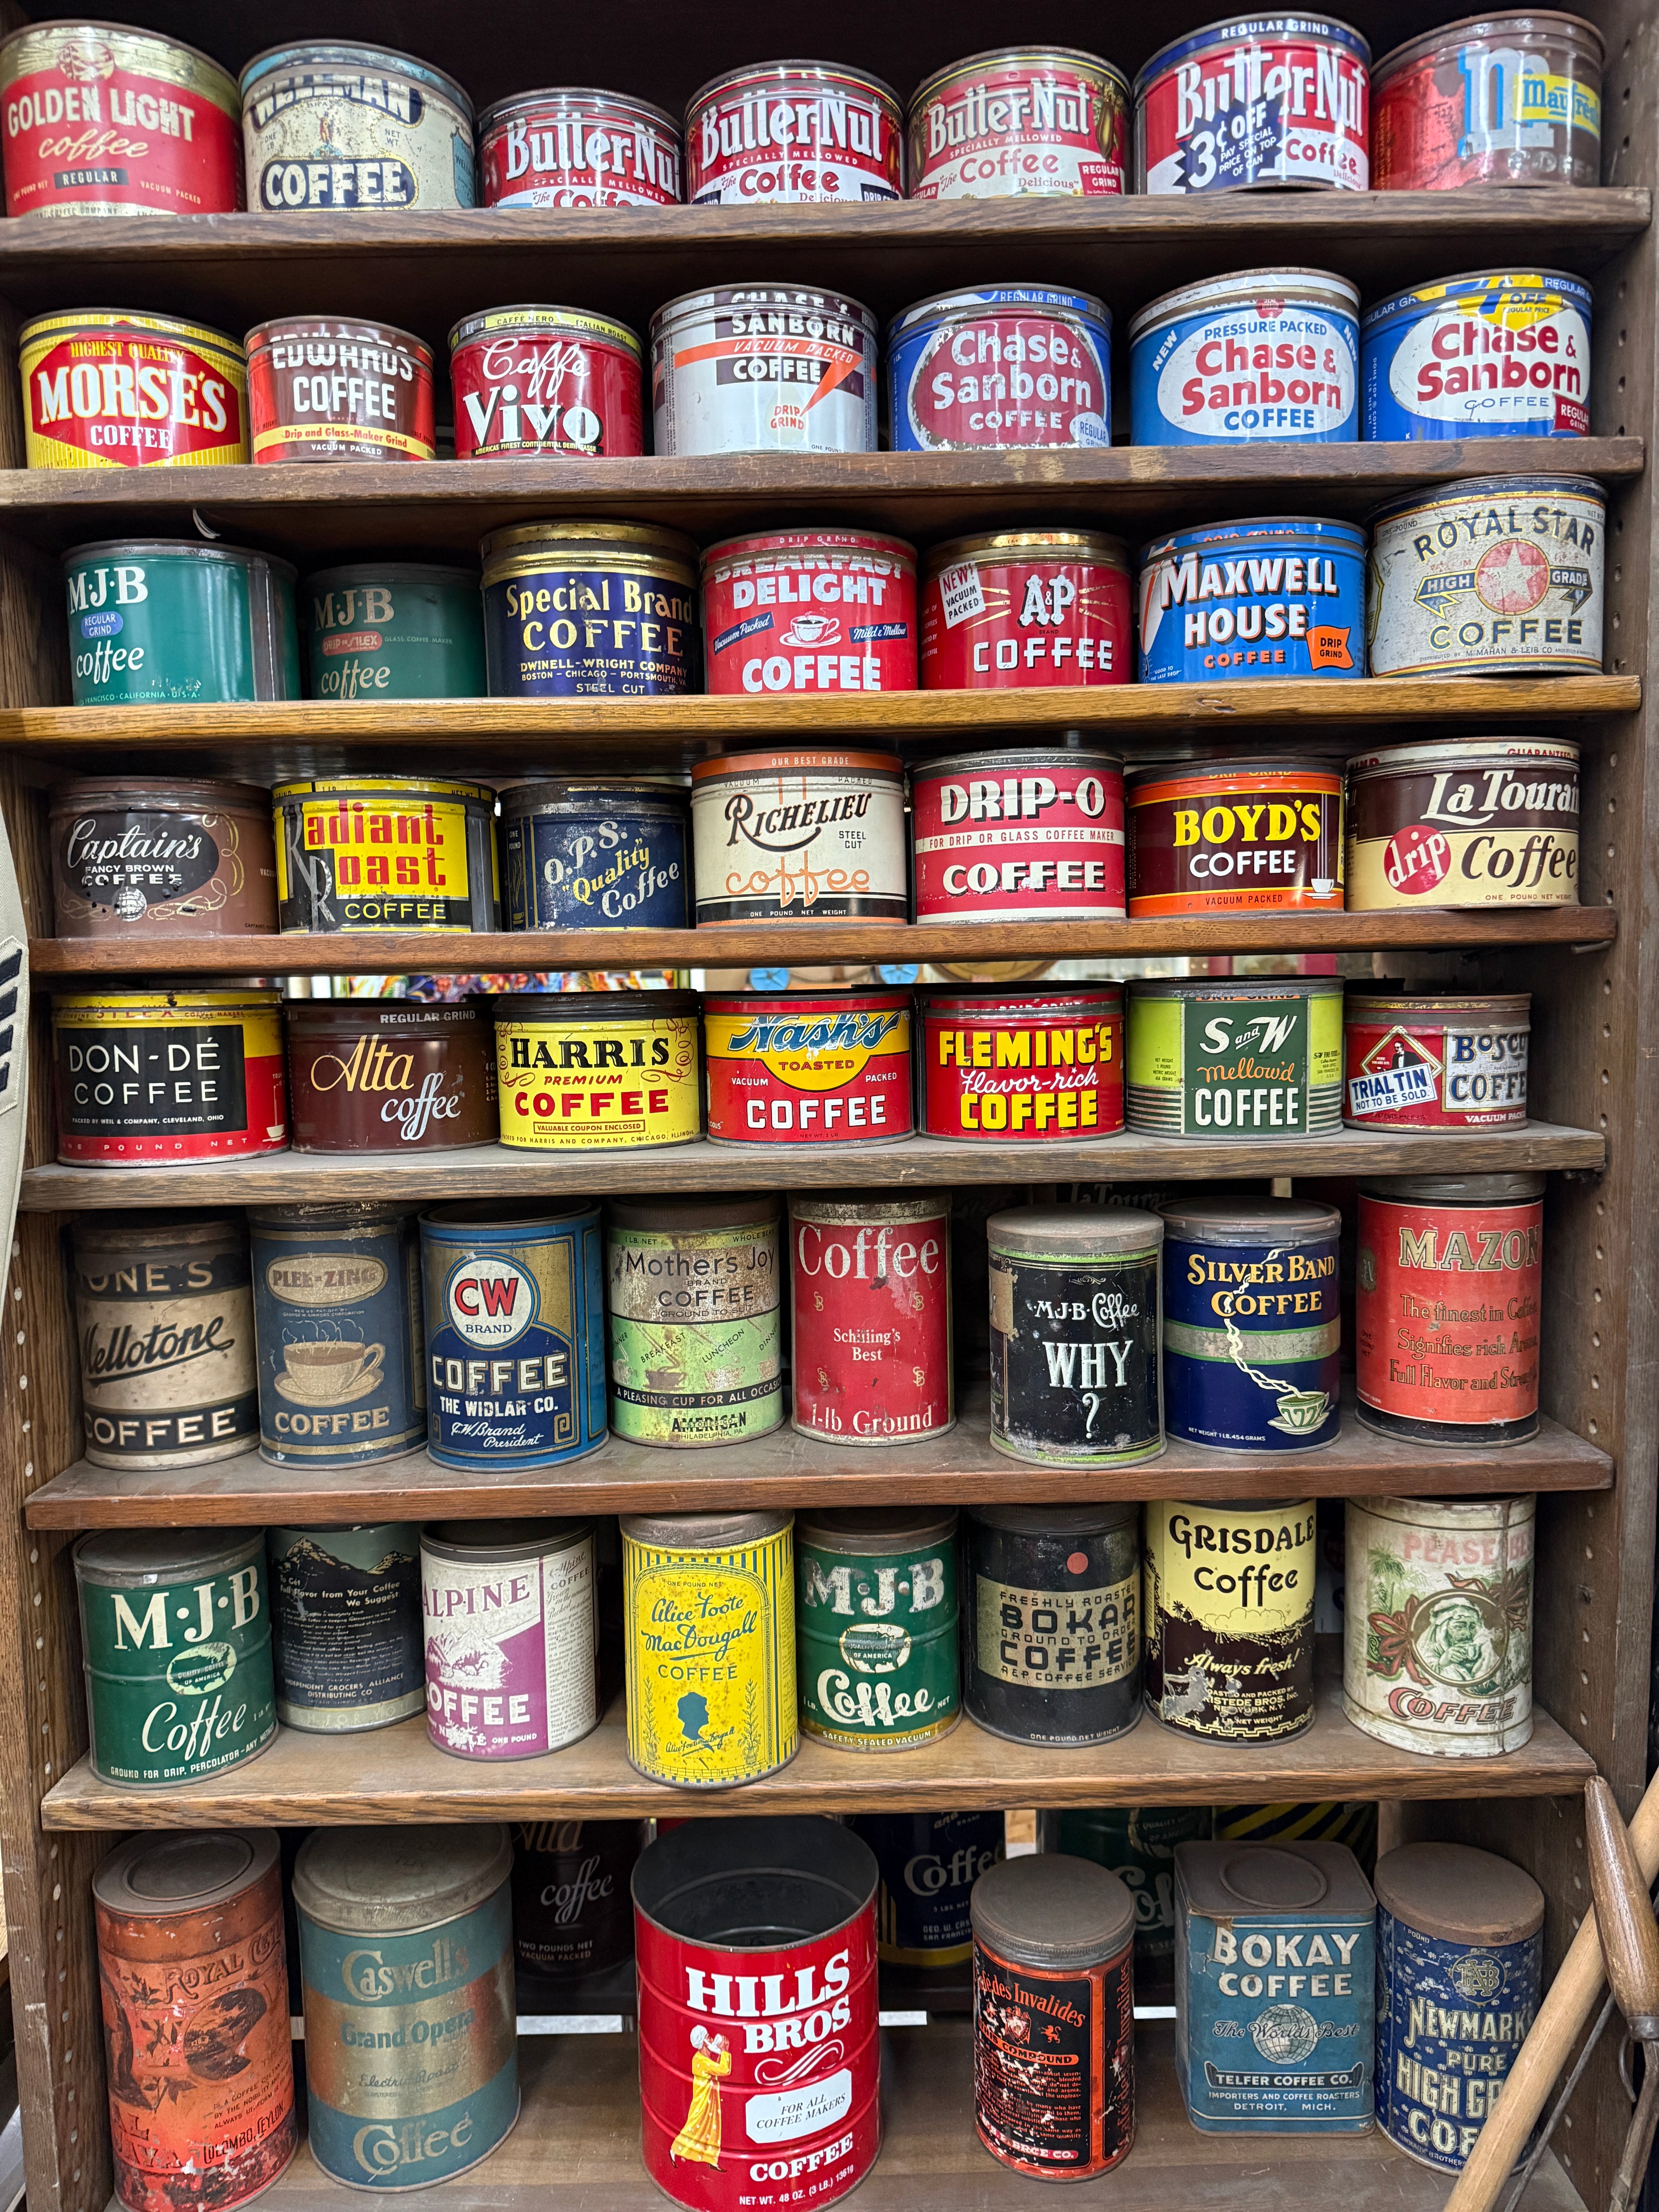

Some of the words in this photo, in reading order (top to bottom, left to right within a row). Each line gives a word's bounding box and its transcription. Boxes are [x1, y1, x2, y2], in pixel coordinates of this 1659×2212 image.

[1221, 21, 1285, 38] REGULAR
[1290, 19, 1329, 35] GRIND
[7, 84, 101, 137] GOLDEN
[110, 88, 195, 142] LIGHT
[1231, 101, 1267, 139] OFF
[39, 130, 151, 163] coffee
[62, 172, 118, 186] REGULAR
[1082, 165, 1120, 177] REGULAR
[140, 181, 172, 194] VACUUM
[176, 190, 201, 204] PACKED
[266, 161, 407, 206] COFFEE
[1092, 177, 1117, 187] GRIND
[1204, 321, 1278, 339] PRESSURE
[1280, 321, 1328, 336] PACKED
[70, 341, 123, 358] HIGHEST
[128, 343, 185, 364] QUALITY
[734, 340, 799, 352] VACUUM
[805, 342, 853, 363] PACKED
[1195, 338, 1317, 376] Chase
[1323, 348, 1336, 374] &
[733, 359, 821, 381] COFFEE
[37, 363, 226, 433] MORSE'S
[294, 376, 396, 420] COFFEE
[1182, 372, 1341, 415] Sanborn
[463, 384, 601, 445] Vivo
[774, 405, 800, 417] DRIP
[1224, 409, 1315, 430] COFFEE
[770, 417, 804, 430] GRIND
[90, 425, 171, 448] COFFEE
[285, 427, 302, 439] Drip
[305, 428, 321, 438] and
[326, 428, 383, 445] Glass-Maker
[385, 435, 408, 448] Grind
[311, 443, 347, 453] VACUUM
[350, 445, 382, 455] PACKED
[1161, 551, 1338, 609] MAXWELL
[1427, 573, 1470, 594] HIGH
[507, 579, 611, 618] Special
[624, 579, 693, 624] Brand
[733, 573, 886, 610] DELIGHT
[84, 614, 116, 627] REGULAR
[88, 624, 112, 636] GRIND
[1185, 603, 1309, 647] HOUSE
[1320, 637, 1343, 649] DRIP
[1476, 647, 1506, 656] MAHAN
[1204, 650, 1286, 669] COFFEE
[1319, 649, 1343, 659] GRIND
[520, 658, 634, 672] DWINELL-WRIGHT
[639, 662, 688, 677] COMPANY
[576, 684, 615, 694] STEEL
[622, 684, 645, 694] CUT
[771, 757, 790, 766] OUR
[794, 757, 817, 766] BEST
[821, 757, 850, 765] GRADE
[940, 777, 1106, 824] DRIP-O
[1173, 800, 1321, 847] BOYD'S
[839, 831, 866, 840] STEEL
[929, 838, 944, 849] FOR
[949, 834, 973, 845] DRIP
[979, 833, 993, 843] OR
[1001, 831, 1039, 842] GLASS
[1046, 830, 1084, 840] COFFEE
[1090, 831, 1115, 841] MAKER
[85, 864, 122, 874] FANCY
[125, 864, 175, 873] BROWN
[1388, 831, 1446, 888] drip
[1205, 895, 1243, 905] VACUUM
[1248, 895, 1283, 903] PACKED
[345, 903, 446, 919] COFFEE
[381, 1013, 439, 1024] REGULAR
[443, 1010, 476, 1021] GRIND
[510, 1037, 670, 1068] HARRIS
[939, 1023, 1112, 1068] FLEMING'S
[778, 1060, 855, 1071] TOASTED
[544, 1075, 622, 1085] PREMIUM
[732, 1077, 768, 1086] VACUUM
[865, 1073, 897, 1082] PACKED
[1352, 1076, 1394, 1100] TRIAL
[1395, 1068, 1427, 1088] TIN
[381, 1071, 463, 1141] coffee
[1196, 1087, 1298, 1126] COFFEE
[1356, 1100, 1370, 1111] NOT
[1386, 1095, 1398, 1104] BE
[1401, 1090, 1430, 1102] SOLD.
[598, 1123, 641, 1131] ENCLOSED
[1187, 1254, 1284, 1285] SILVER
[1287, 1254, 1334, 1282] BAND
[455, 1278, 519, 1316] CW
[1211, 1291, 1322, 1317] COFFEE
[465, 1324, 512, 1334] BRAND
[833, 1328, 900, 1344] Schilling's
[640, 1332, 686, 1364] BREAKFAST
[701, 1328, 745, 1364] LUNCHEON
[852, 1348, 882, 1361] Best
[1042, 1340, 1134, 1388] WHY
[440, 1397, 461, 1413] THE
[465, 1400, 526, 1417] WIDLAR
[534, 1396, 558, 1413] CO.
[1169, 1514, 1314, 1559] GRISDALE
[322, 1590, 343, 1598] from
[347, 1587, 368, 1597] Your
[373, 1581, 400, 1592] Coffee
[1194, 1564, 1298, 1607] Coffee
[1000, 1592, 1073, 1608] FRESHLY
[1000, 1596, 1135, 1635] BOKAR
[1184, 1654, 1251, 1675] Always
[1254, 1649, 1300, 1674] fresh!
[658, 1666, 738, 1681] COFFEE
[511, 1733, 537, 1743] POUND
[110, 1765, 139, 1778] GROUND
[143, 1769, 159, 1778] FOR
[1213, 1928, 1360, 1968] BOKAY
[685, 1948, 850, 2016] HILLS
[1218, 1972, 1353, 1997] COFFEE
[342, 2021, 405, 2048] Grand
[412, 2009, 474, 2044] Opera
[743, 1994, 851, 2054] BROS
[1216, 2073, 1269, 2086] TELFER
[1274, 2075, 1325, 2086] COFFEE
[1329, 2074, 1353, 2085] CO.
[780, 2102, 803, 2114] FOR
[806, 2094, 826, 2108] ALL
[1209, 2091, 1259, 2100] IMPORTERS
[1261, 2092, 1280, 2100] AND
[1283, 2092, 1314, 2100] COFFEE
[1317, 2091, 1359, 2100] ROASTERS
[756, 2114, 802, 2129] COFFEE
[805, 2092, 846, 2123] MAKERS
[1302, 2102, 1336, 2111] MICH.
[750, 2132, 853, 2182] COFFEE
[739, 2197, 755, 2205] NET
[760, 2195, 776, 2205] WT.
[779, 2193, 790, 2203] 48
[792, 2190, 805, 2201] OZ.
[809, 2185, 816, 2196] (3
[819, 2178, 833, 2192] LB.)
